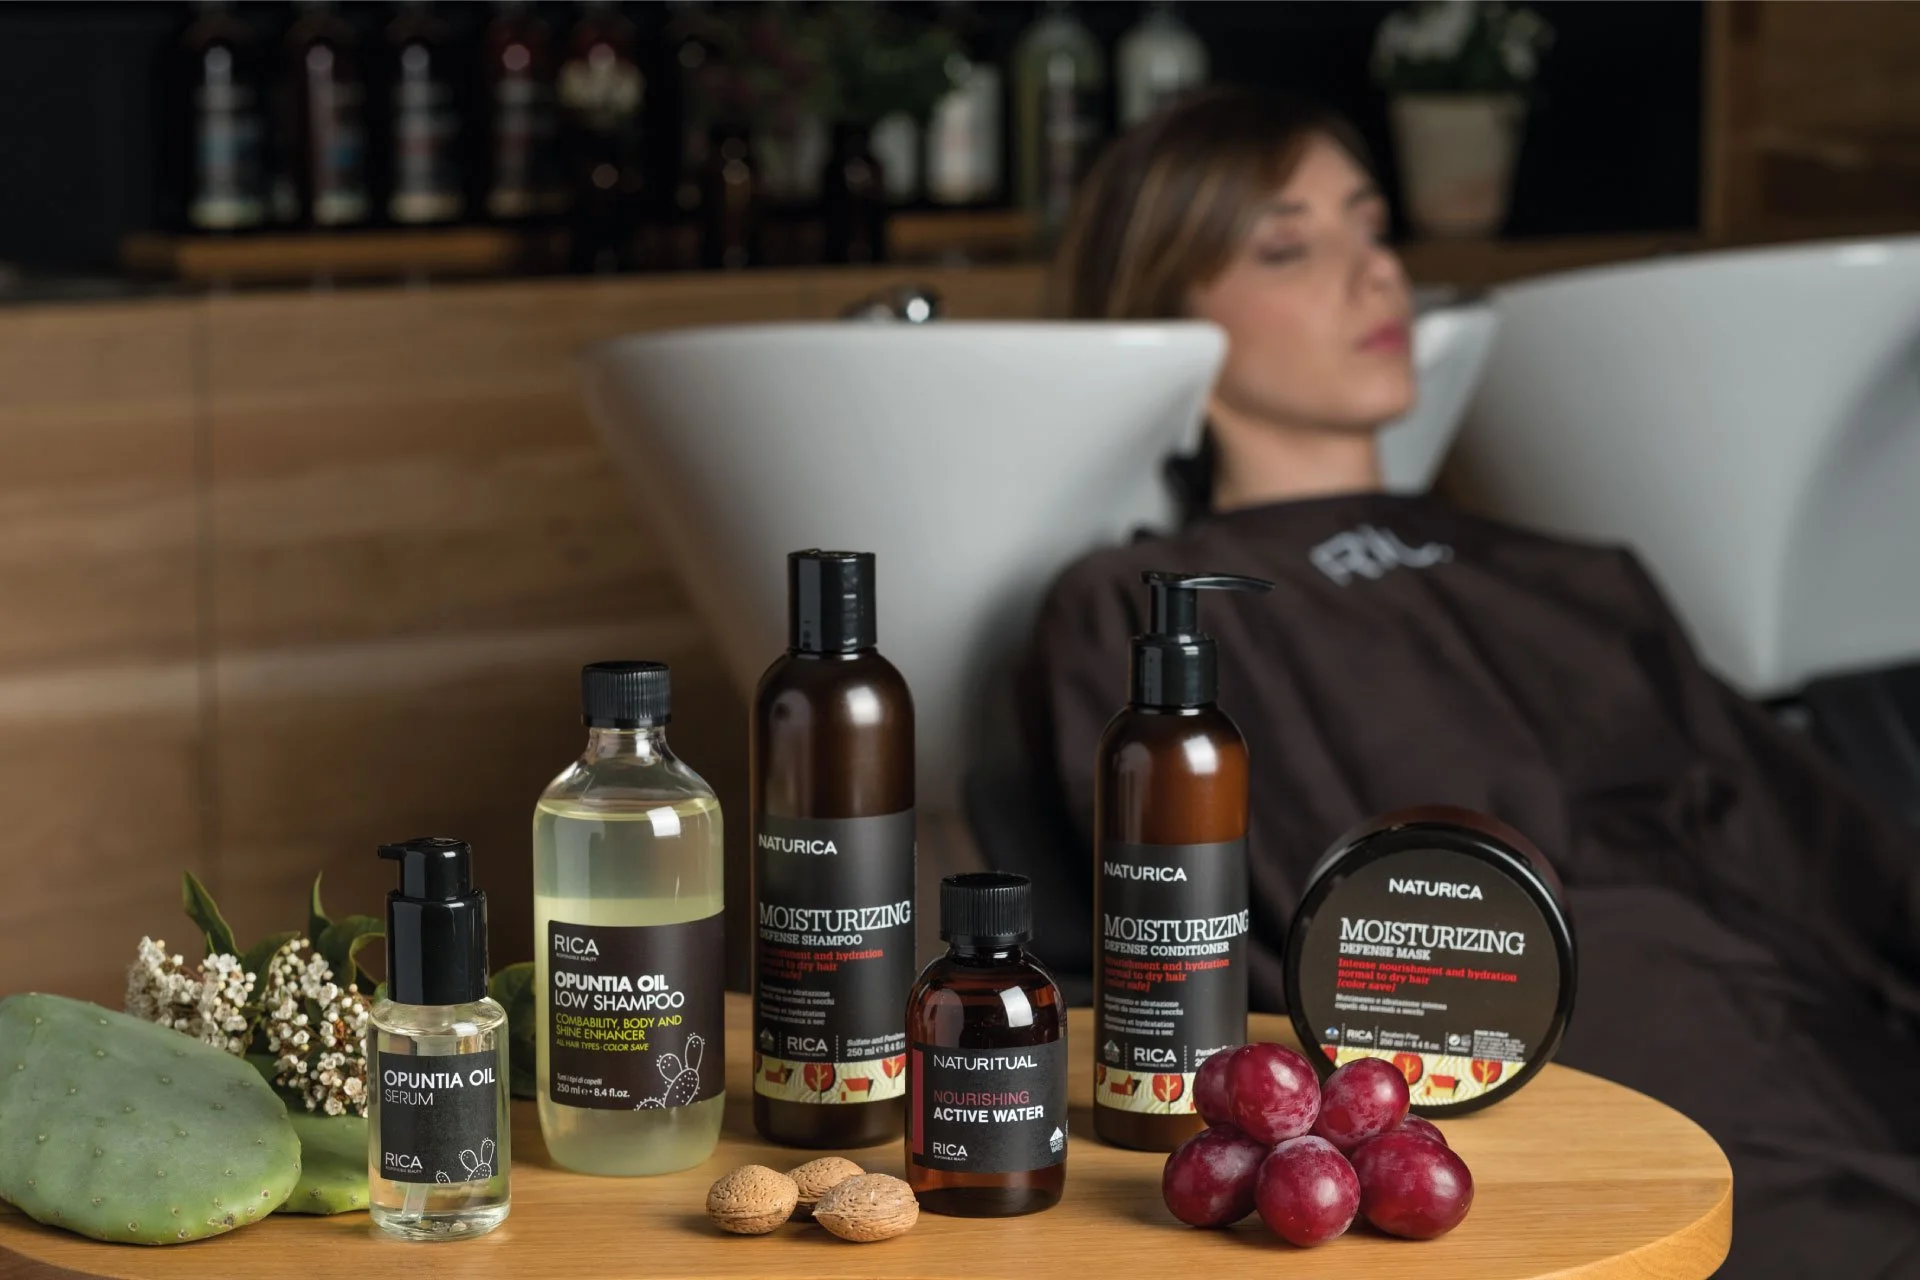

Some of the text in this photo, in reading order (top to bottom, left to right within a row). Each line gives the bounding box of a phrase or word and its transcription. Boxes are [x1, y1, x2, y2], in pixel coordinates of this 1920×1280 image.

[758, 833, 838, 855] NATURICA
[1104, 861, 1187, 882] NATURICA
[1388, 878, 1483, 900] NATURICA
[759, 900, 911, 932] MOISTURIZING
[1104, 909, 1249, 942] MOISTURIZING
[554, 934, 600, 956] RICA
[760, 928, 863, 946] DEFENSE SHAMPOO
[1339, 917, 1525, 955] MOISTURIZING
[813, 951, 833, 960] and
[836, 949, 884, 962] hydration
[1104, 939, 1230, 957] DEFENSE CONDITIONER
[1339, 942, 1431, 960] DEFENSE MASK
[1162, 962, 1183, 970] and
[1184, 959, 1230, 972] hydration
[1338, 959, 1517, 982] Intense nourishment and hydration
[555, 971, 669, 992] OPUNTIA OIL
[1133, 971, 1144, 980] to
[1145, 972, 1163, 983] dry
[1165, 972, 1188, 981] hair
[1337, 970, 1430, 985] normal to dry hair
[555, 989, 685, 1011] LOW SHAMPOO
[556, 1012, 682, 1030] COMBABILITY, BODY AND
[556, 1024, 646, 1041] SHINE ENHANCER
[1346, 1028, 1373, 1041] RICA
[566, 1040, 580, 1048] HAIR
[630, 1043, 649, 1051] SAVE
[787, 1036, 828, 1053] RICA
[847, 1047, 863, 1057] 250
[864, 1046, 875, 1056] ml
[933, 1055, 1037, 1070] NATURITUAL
[1134, 1047, 1177, 1063] RICA
[384, 1068, 495, 1089] OPUNTIA OIL
[385, 1088, 433, 1106] SERUM
[557, 1083, 569, 1093] 250
[570, 1085, 580, 1094] ml
[594, 1088, 607, 1097] 8.4
[609, 1088, 630, 1098] fl.oz.
[933, 1090, 1029, 1106] NOURISHING
[933, 1105, 1044, 1123] ACTIVE WATER
[933, 1142, 968, 1157] RICA
[385, 1152, 423, 1169] RICA
